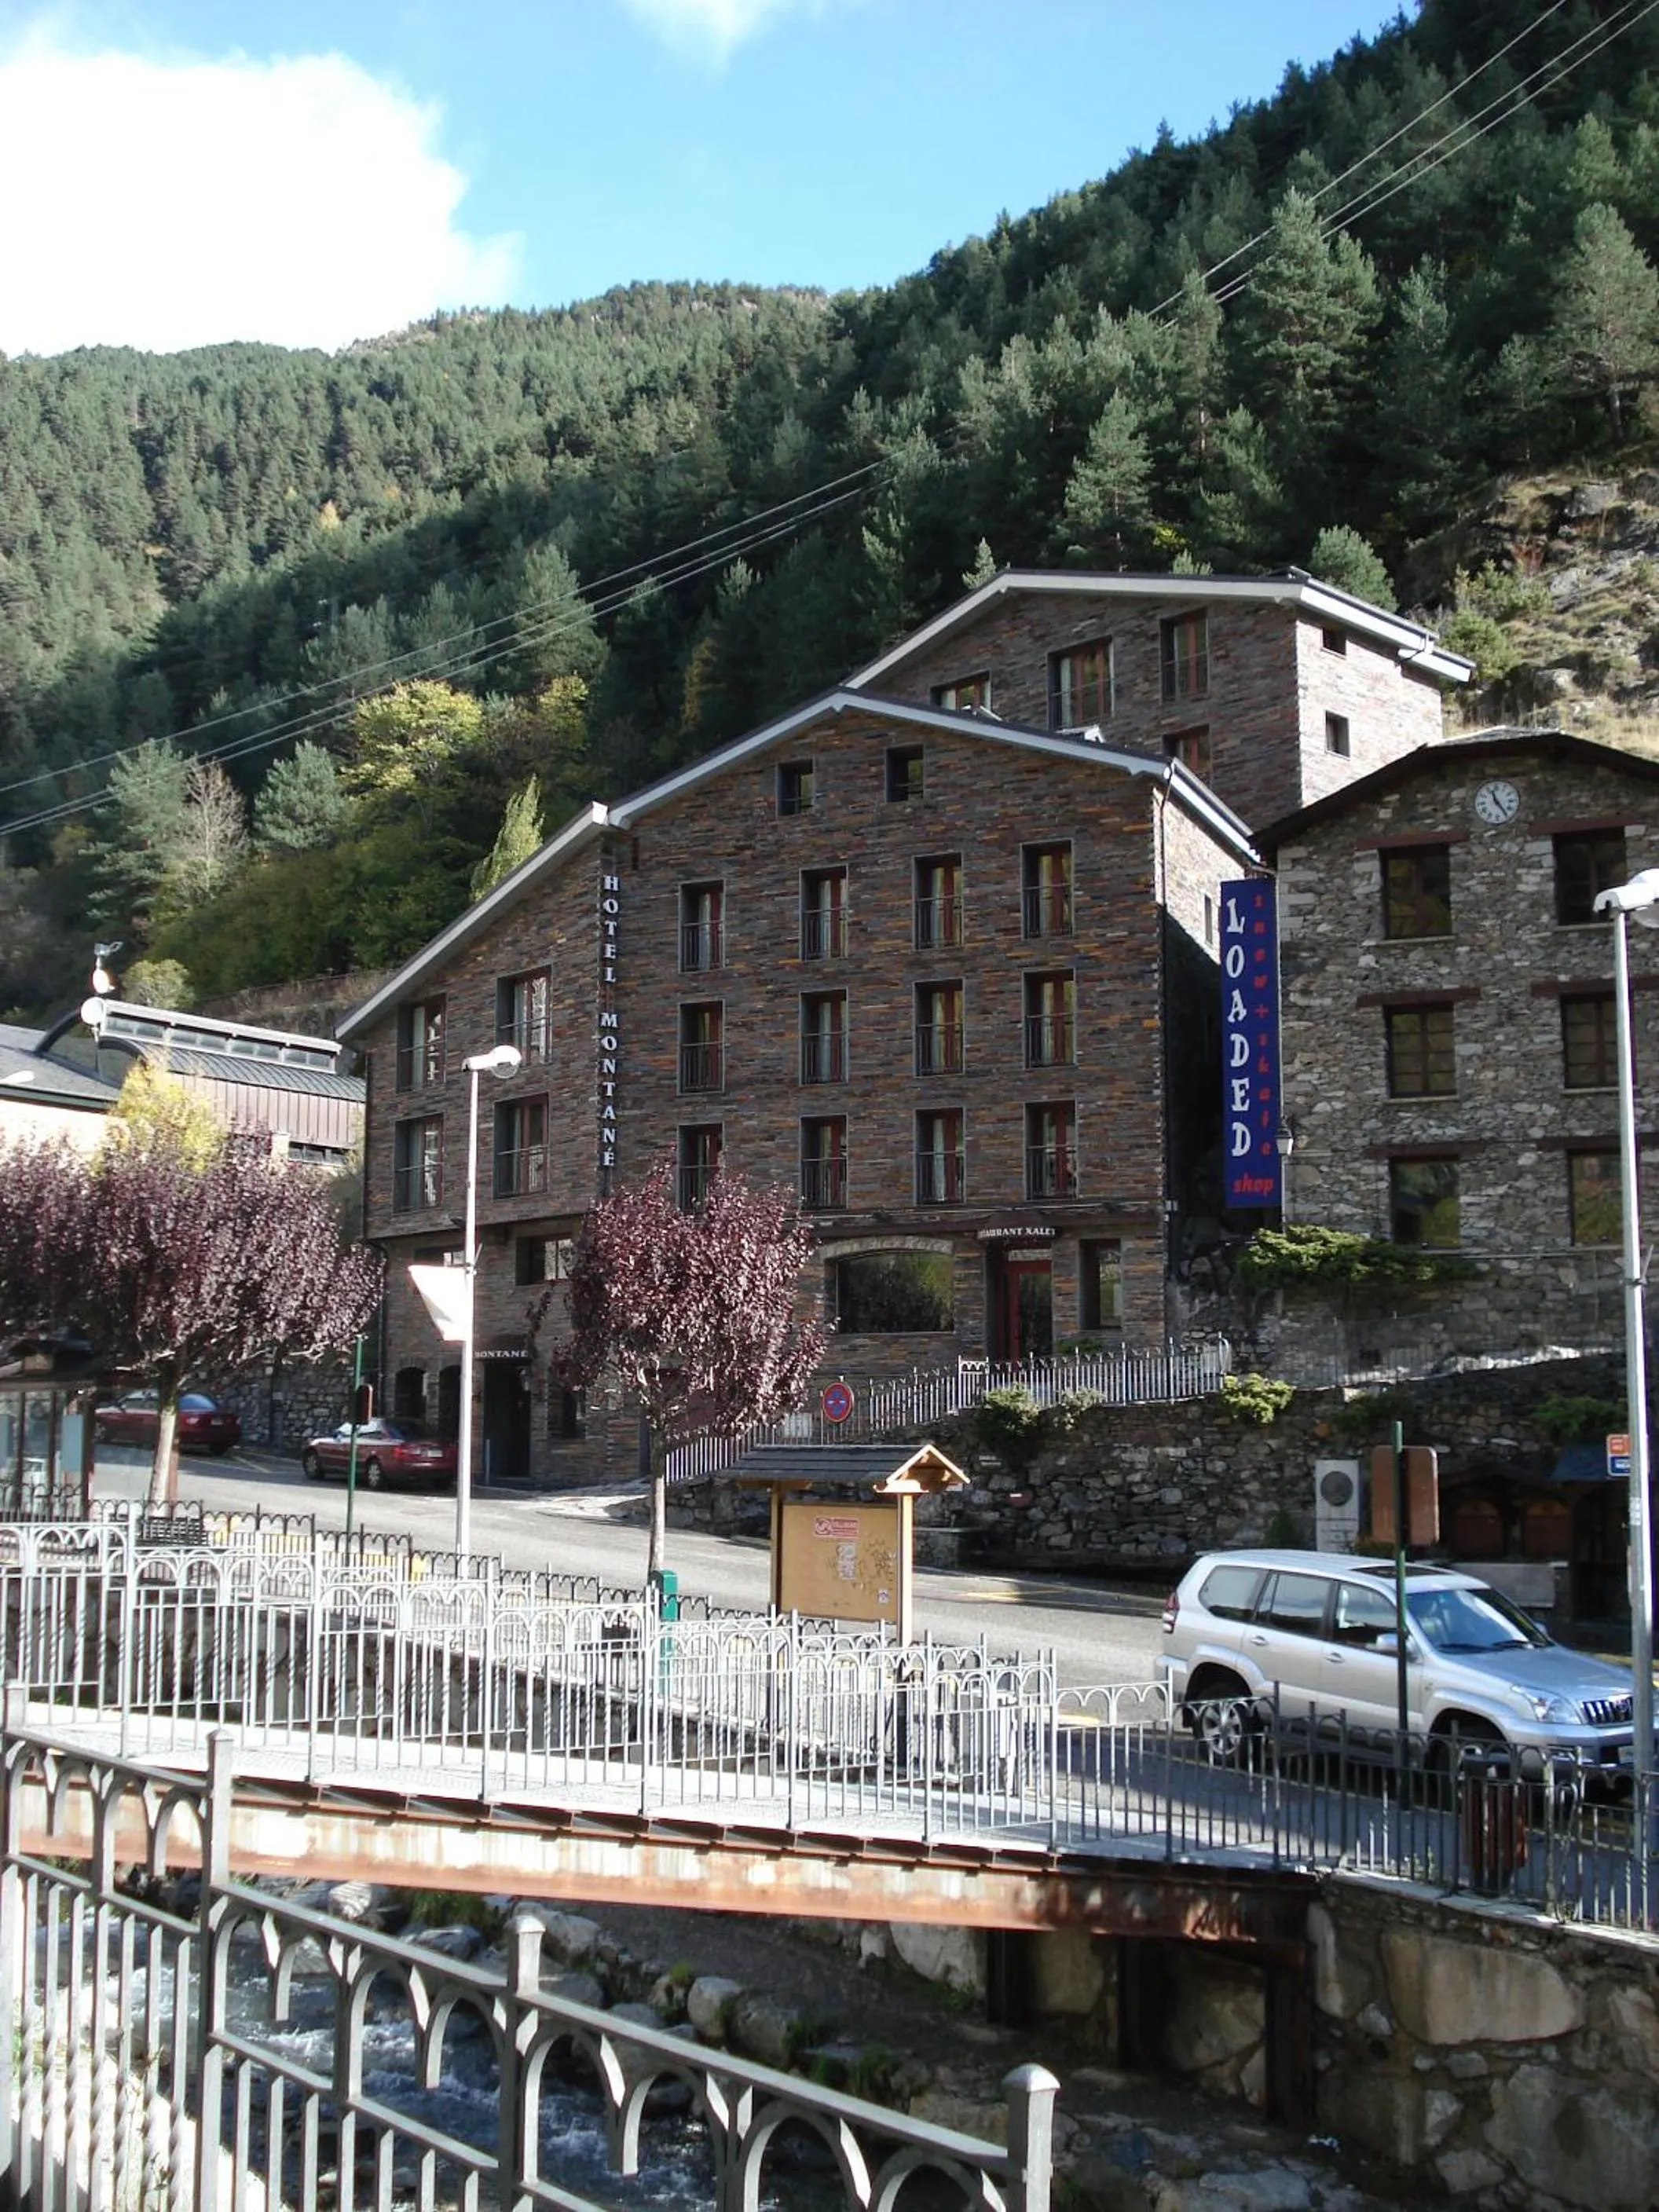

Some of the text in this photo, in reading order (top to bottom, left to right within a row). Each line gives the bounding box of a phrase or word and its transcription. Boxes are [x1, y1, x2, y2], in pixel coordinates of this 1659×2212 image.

[599, 875, 619, 1166] HOTEL MONTANÉ
[1225, 897, 1251, 1157] LOADED
[1258, 1033, 1271, 1156] skate
[1232, 1173, 1274, 1203] shop
